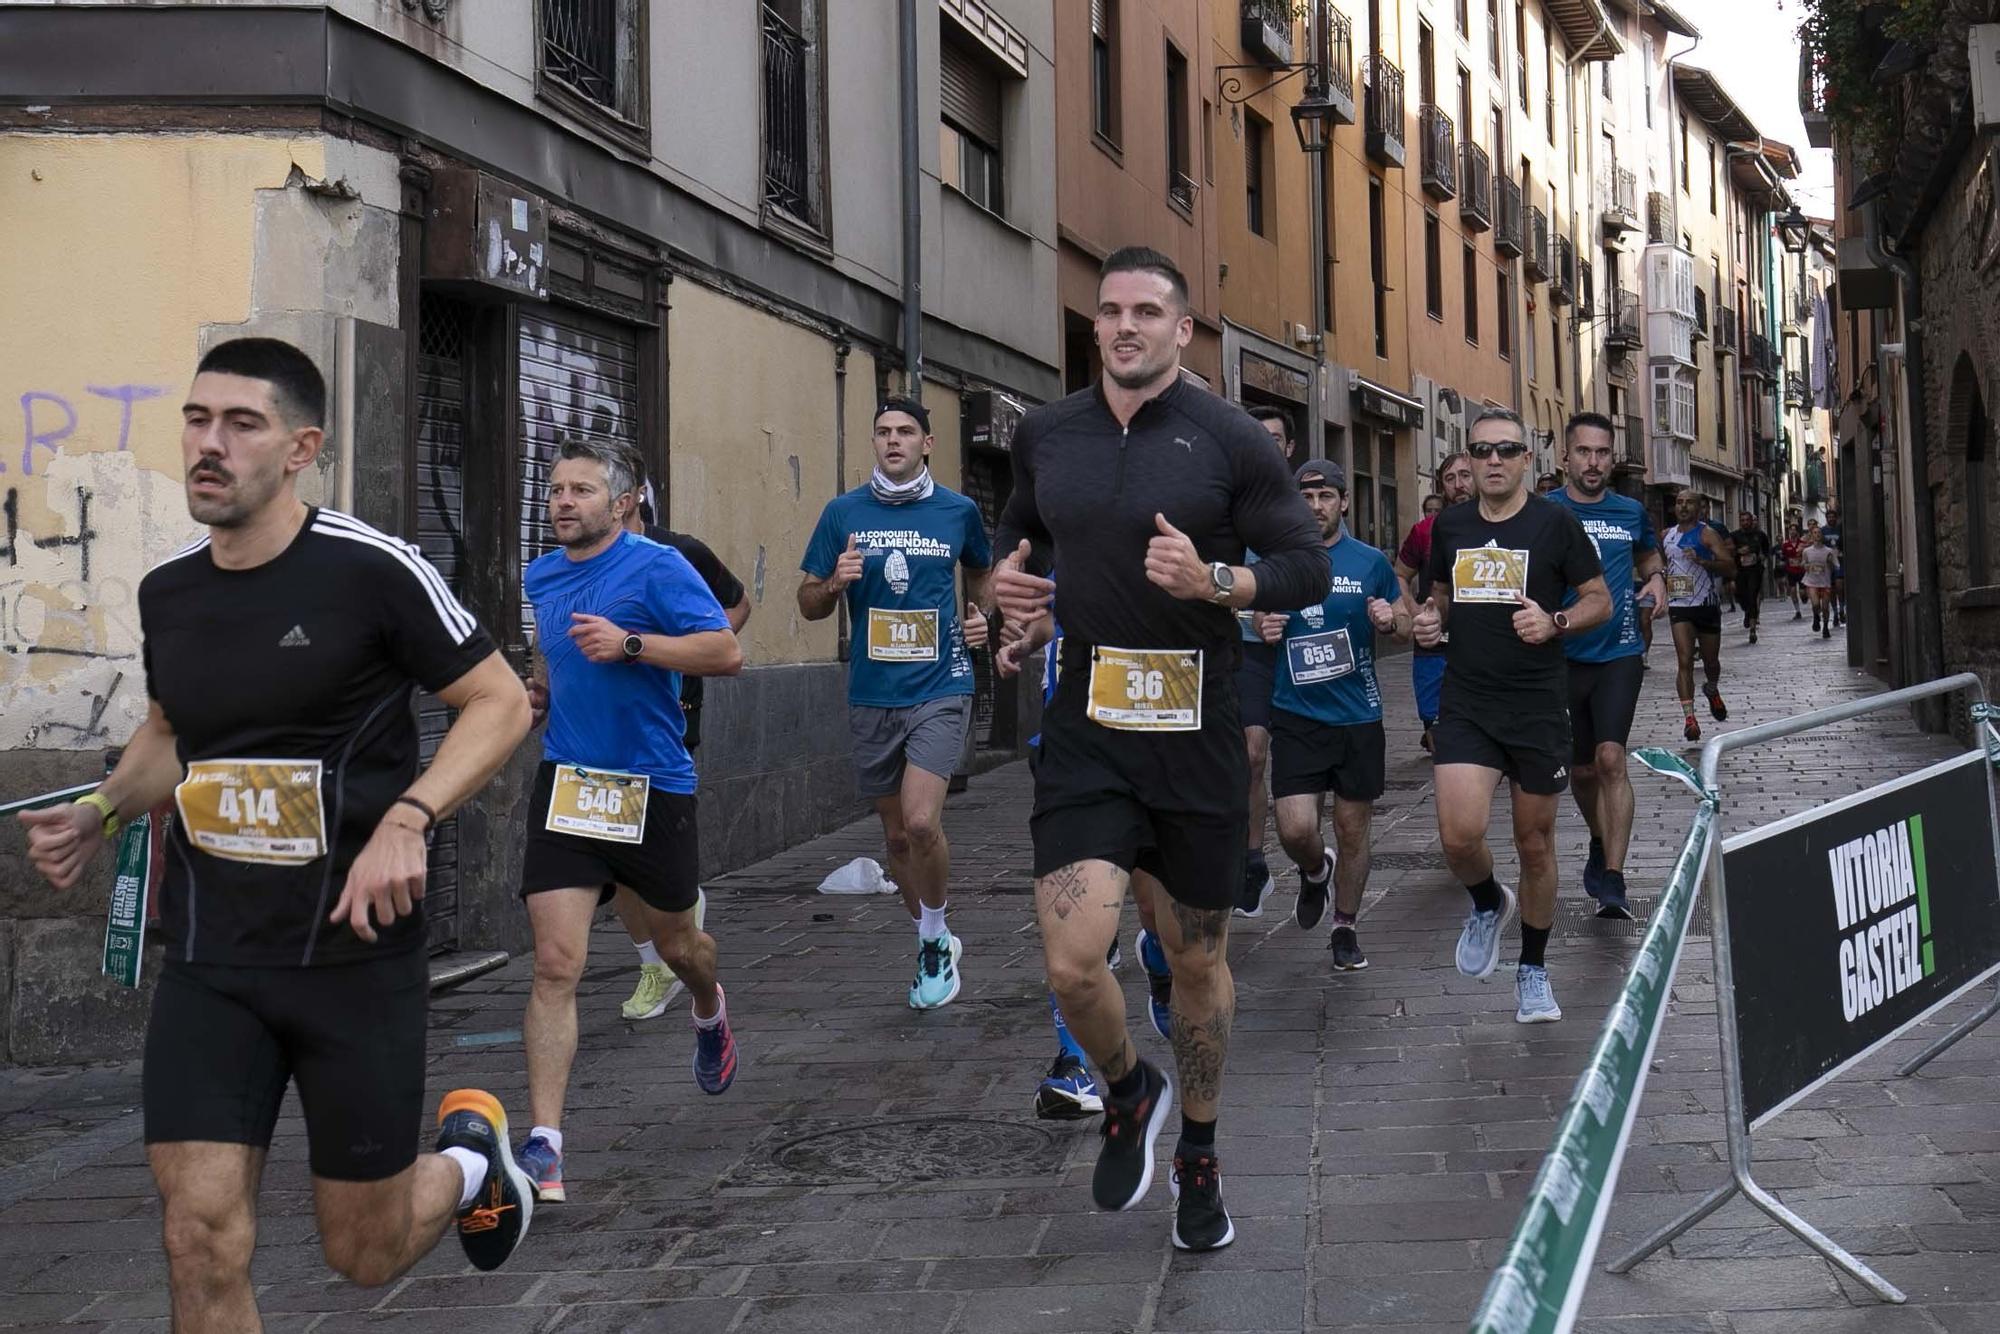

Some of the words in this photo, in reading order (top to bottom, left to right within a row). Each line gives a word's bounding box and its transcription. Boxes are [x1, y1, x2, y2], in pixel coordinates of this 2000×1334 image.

[855, 531, 867, 539] LA
[867, 530, 920, 539] CONQUISTA
[869, 538, 940, 548] ALMENDRA
[906, 547, 951, 558] KONKISTA
[1334, 576, 1350, 586] RA
[1473, 560, 1506, 582] 222
[1332, 585, 1363, 594] NKISTA
[889, 624, 917, 642] 141
[1303, 644, 1336, 666] 855
[1126, 670, 1164, 700] 36
[290, 771, 312, 784] 10K
[219, 788, 280, 826] 414
[577, 785, 623, 815] 546
[1828, 819, 1916, 931] VITORIA
[112, 875, 129, 918] GASTEIZ
[123, 876, 140, 918] VITORIA
[1839, 904, 1923, 1022] GASTEIZ
